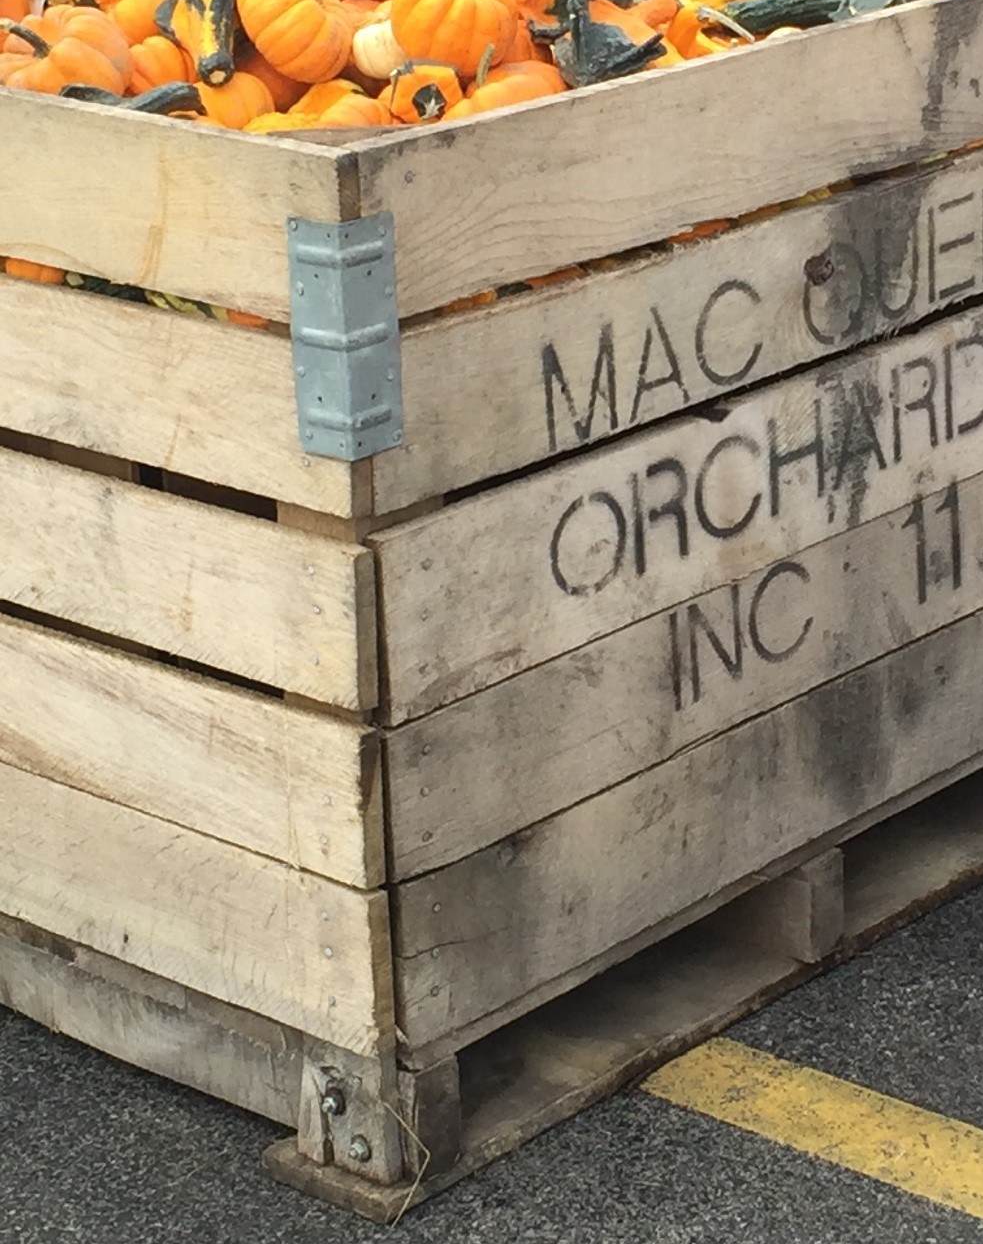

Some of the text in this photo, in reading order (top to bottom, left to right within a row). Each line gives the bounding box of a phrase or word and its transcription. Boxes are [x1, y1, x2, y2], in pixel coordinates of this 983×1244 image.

[541, 278, 763, 452] MAC
[667, 476, 962, 711] INC 11
